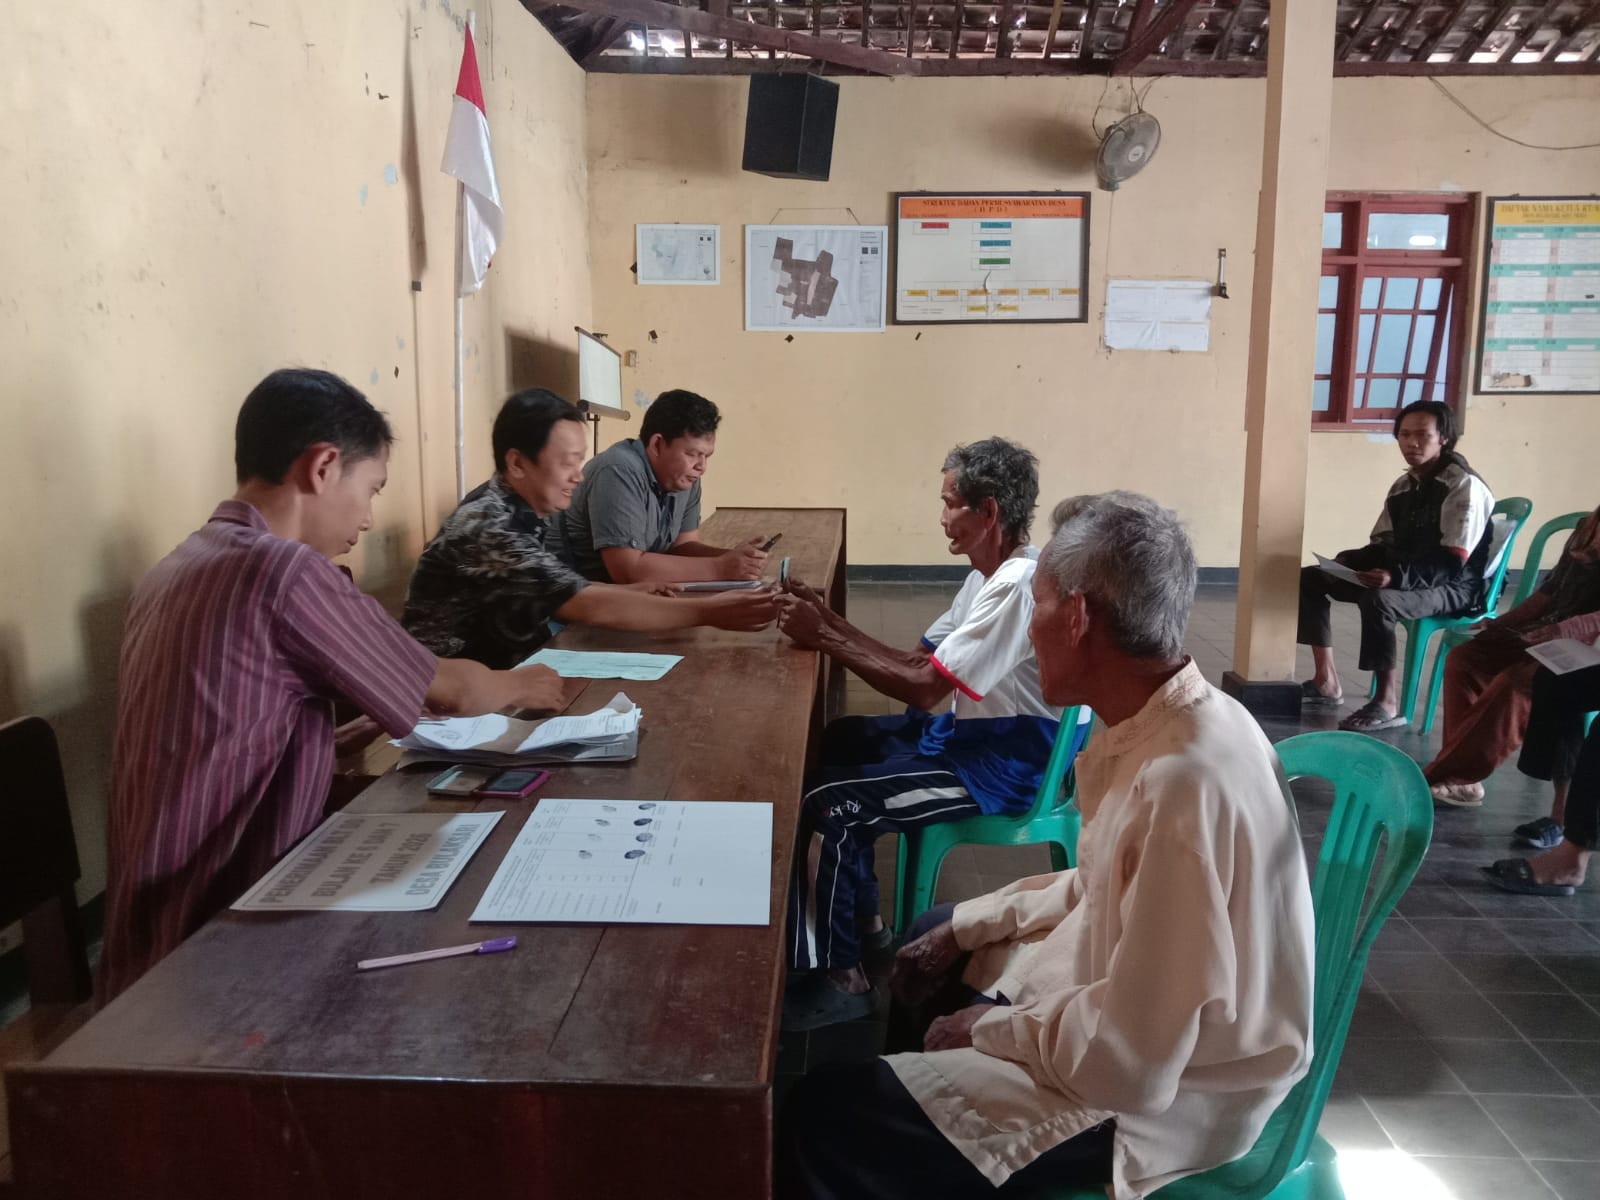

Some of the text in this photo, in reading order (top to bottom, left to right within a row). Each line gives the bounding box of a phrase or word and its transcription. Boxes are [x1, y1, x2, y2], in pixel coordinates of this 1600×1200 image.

[311, 865, 361, 897] BULAN
[343, 852, 371, 865] KE
[362, 828, 394, 845] DAN
[369, 853, 416, 884] TAHUN
[405, 824, 480, 895] DESA BULAKSARI
